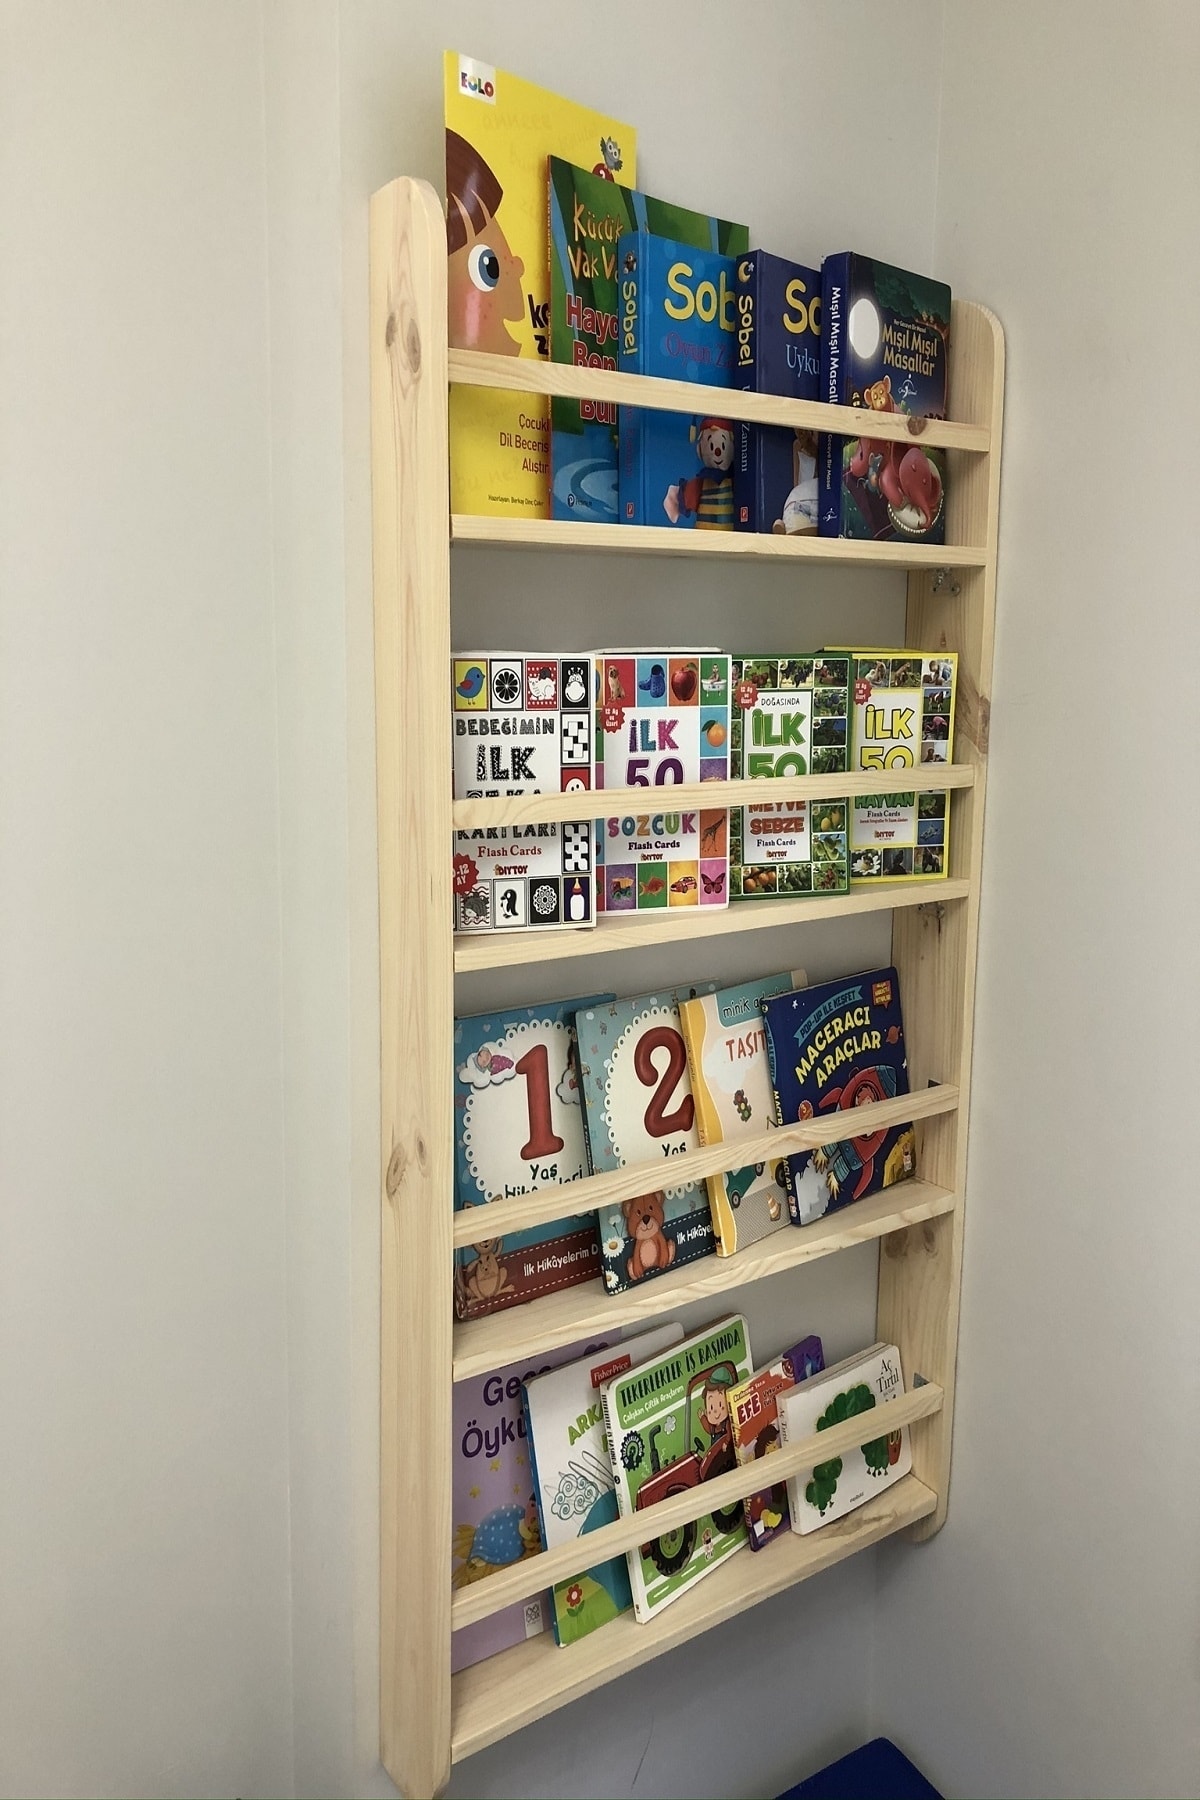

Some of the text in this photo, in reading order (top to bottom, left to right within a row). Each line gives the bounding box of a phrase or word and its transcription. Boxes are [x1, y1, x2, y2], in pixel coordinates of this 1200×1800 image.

[568, 245, 599, 279] Vak
[883, 345, 935, 376] Masallar
[500, 432, 512, 447] Dil
[629, 718, 679, 753] İLK
[751, 708, 807, 747] İLK
[865, 703, 915, 740] İLK
[750, 816, 805, 835] SEBZE
[756, 838, 796, 847] Flash Cards
[477, 844, 542, 858] Flash Cards
[628, 840, 681, 851] Flash Cards
[723, 997, 751, 1018] minik
[794, 1006, 871, 1085] MACERACI
[634, 1026, 695, 1138] 2
[515, 1044, 564, 1160] 1
[620, 1360, 684, 1408] TEKERLEKLER
[698, 1329, 741, 1365] BAŞINDA
